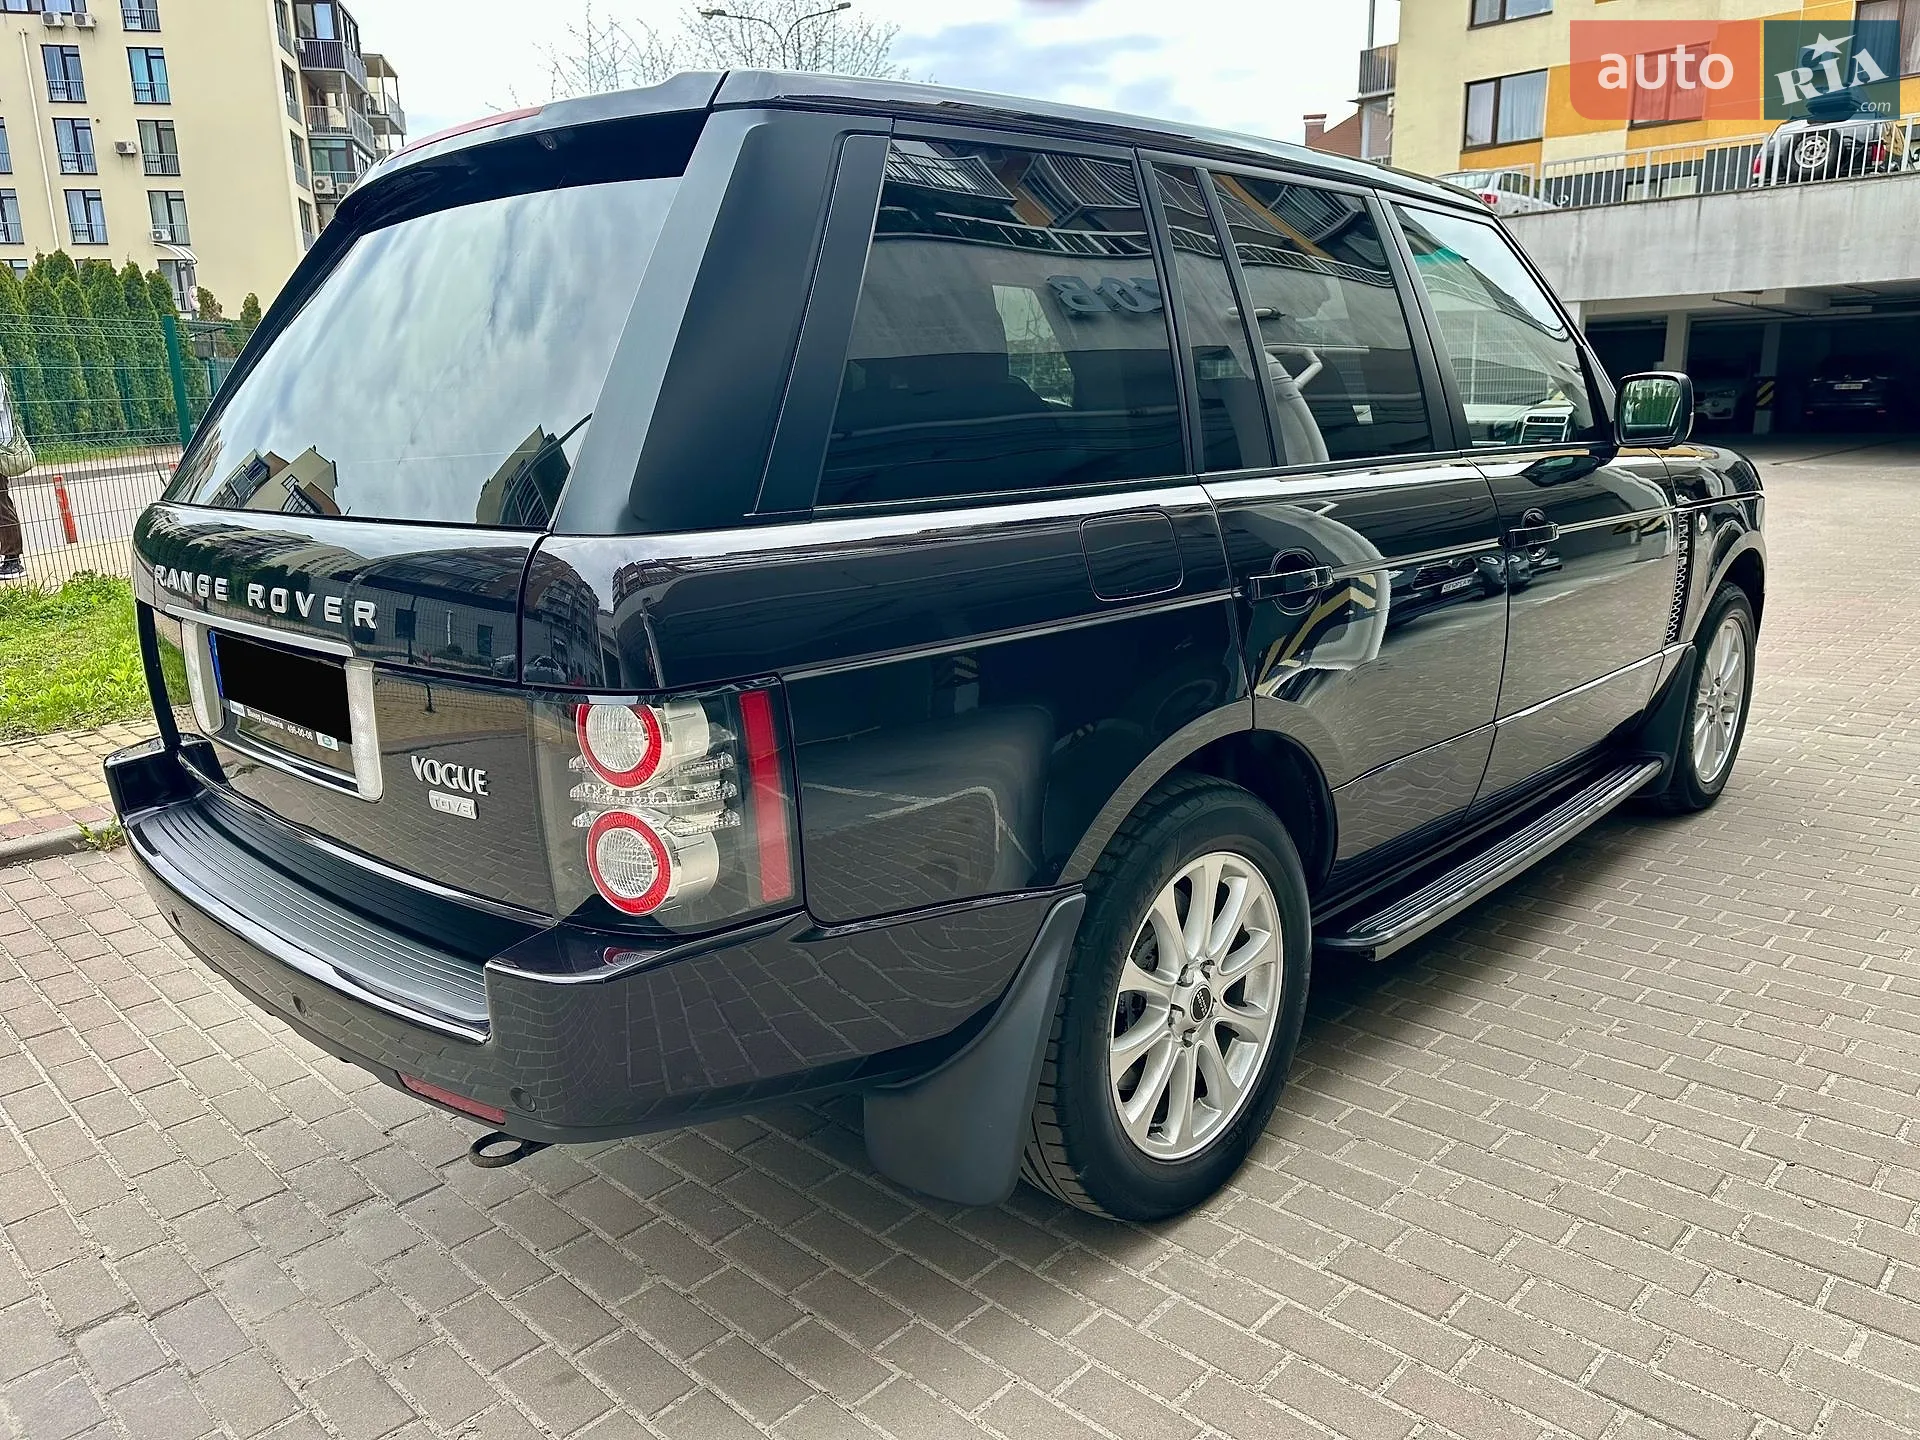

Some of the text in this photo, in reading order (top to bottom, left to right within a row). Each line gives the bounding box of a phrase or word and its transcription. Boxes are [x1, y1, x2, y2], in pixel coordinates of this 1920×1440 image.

[153, 564, 378, 630] RANGE ROVER
[410, 755, 489, 796] VOGUE
